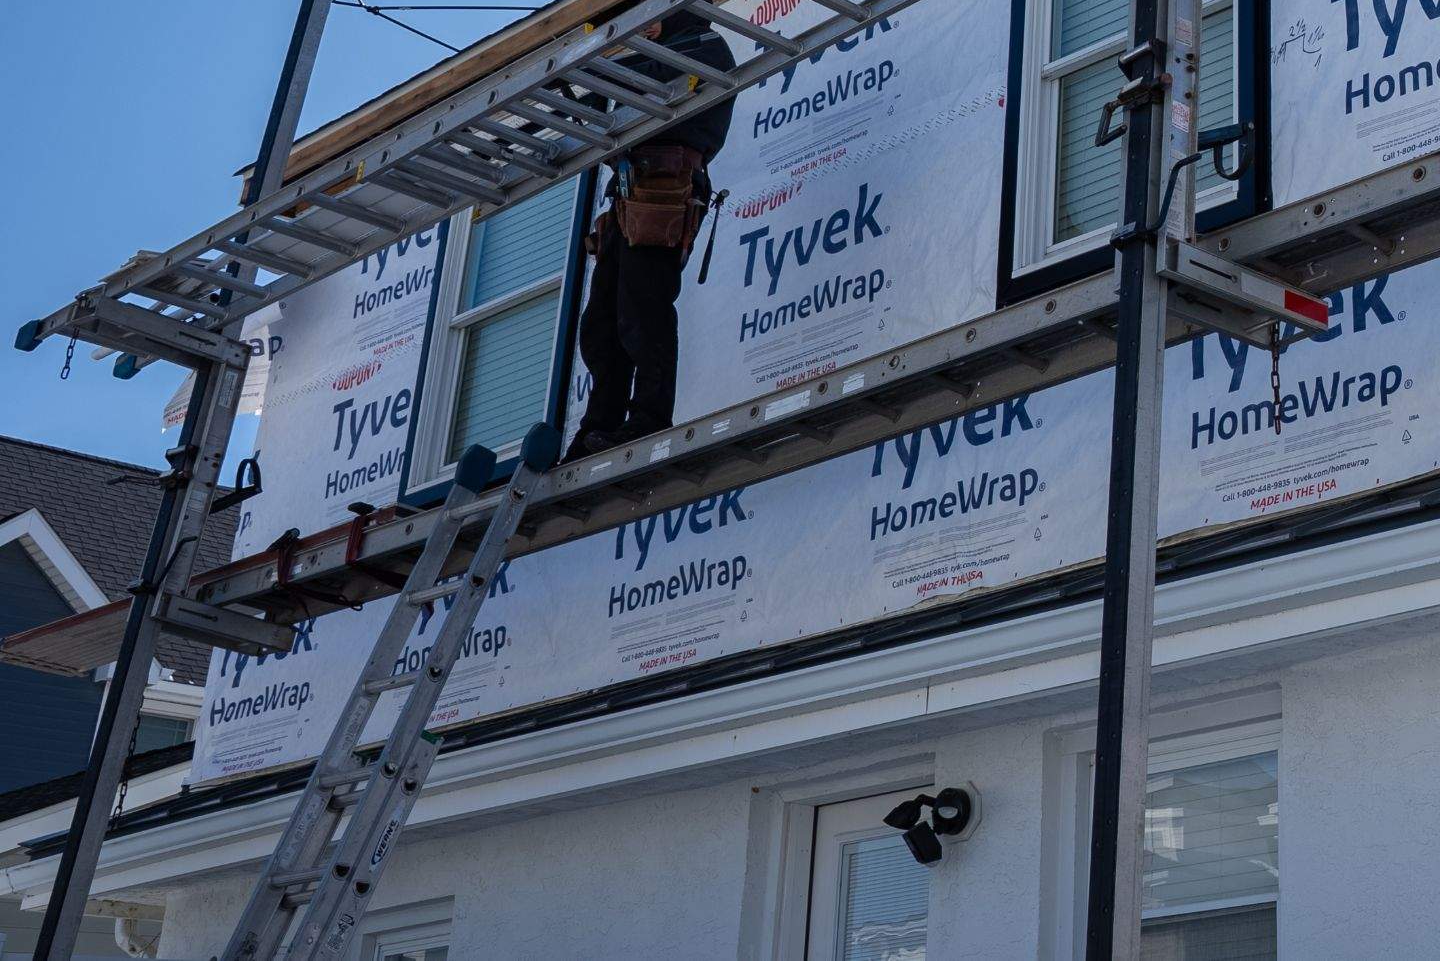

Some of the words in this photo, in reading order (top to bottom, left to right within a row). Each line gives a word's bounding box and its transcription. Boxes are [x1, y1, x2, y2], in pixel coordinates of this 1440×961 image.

[753, 60, 894, 139] HomeWrap
[791, 164, 809, 177] MADE
[811, 160, 817, 169] IN
[820, 155, 831, 166] THE
[833, 148, 847, 159] USA
[1382, 151, 1396, 162] Call
[739, 183, 884, 296] Tyvek
[352, 265, 436, 319] HomeWr
[739, 268, 885, 343] HomeWrap
[1192, 271, 1395, 393] Tyek
[776, 376, 796, 388] MADE
[798, 372, 805, 382] IN
[807, 367, 820, 378] THE
[823, 361, 836, 373] USA
[1191, 365, 1402, 449] HomeWrap
[870, 468, 1039, 541] HomeWrap
[1222, 491, 1235, 502] Call
[1293, 458, 1370, 485] tyvek.com/homewrap
[1250, 494, 1279, 510] MADE
[1282, 491, 1293, 502] IN
[1295, 485, 1315, 499] THE
[1317, 479, 1337, 493] USA
[608, 554, 747, 618] HomeWrap
[892, 580, 904, 589] Call
[390, 624, 507, 680] HomWrap
[640, 660, 659, 671] MADE
[660, 657, 667, 666] IN
[669, 653, 681, 662] THE
[683, 649, 696, 660] USA
[210, 681, 310, 726] HomeWrap
